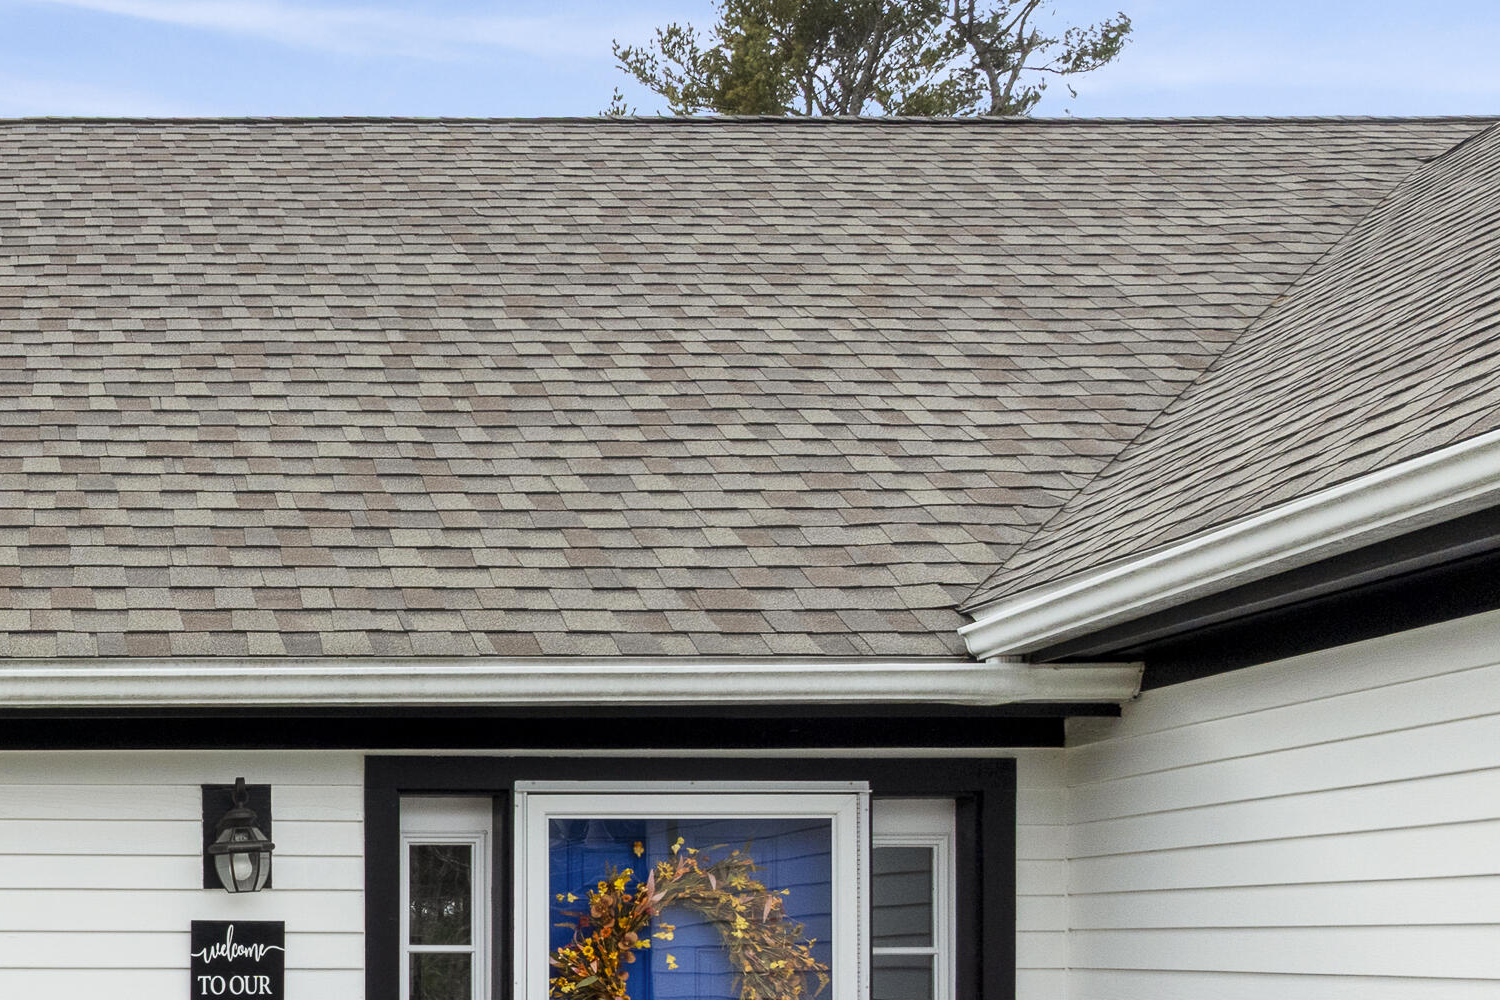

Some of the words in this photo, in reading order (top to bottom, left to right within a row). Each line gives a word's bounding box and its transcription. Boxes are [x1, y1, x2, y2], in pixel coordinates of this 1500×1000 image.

[191, 924, 285, 964] welcome
[198, 975, 226, 995] TO
[229, 975, 272, 995] OUR
